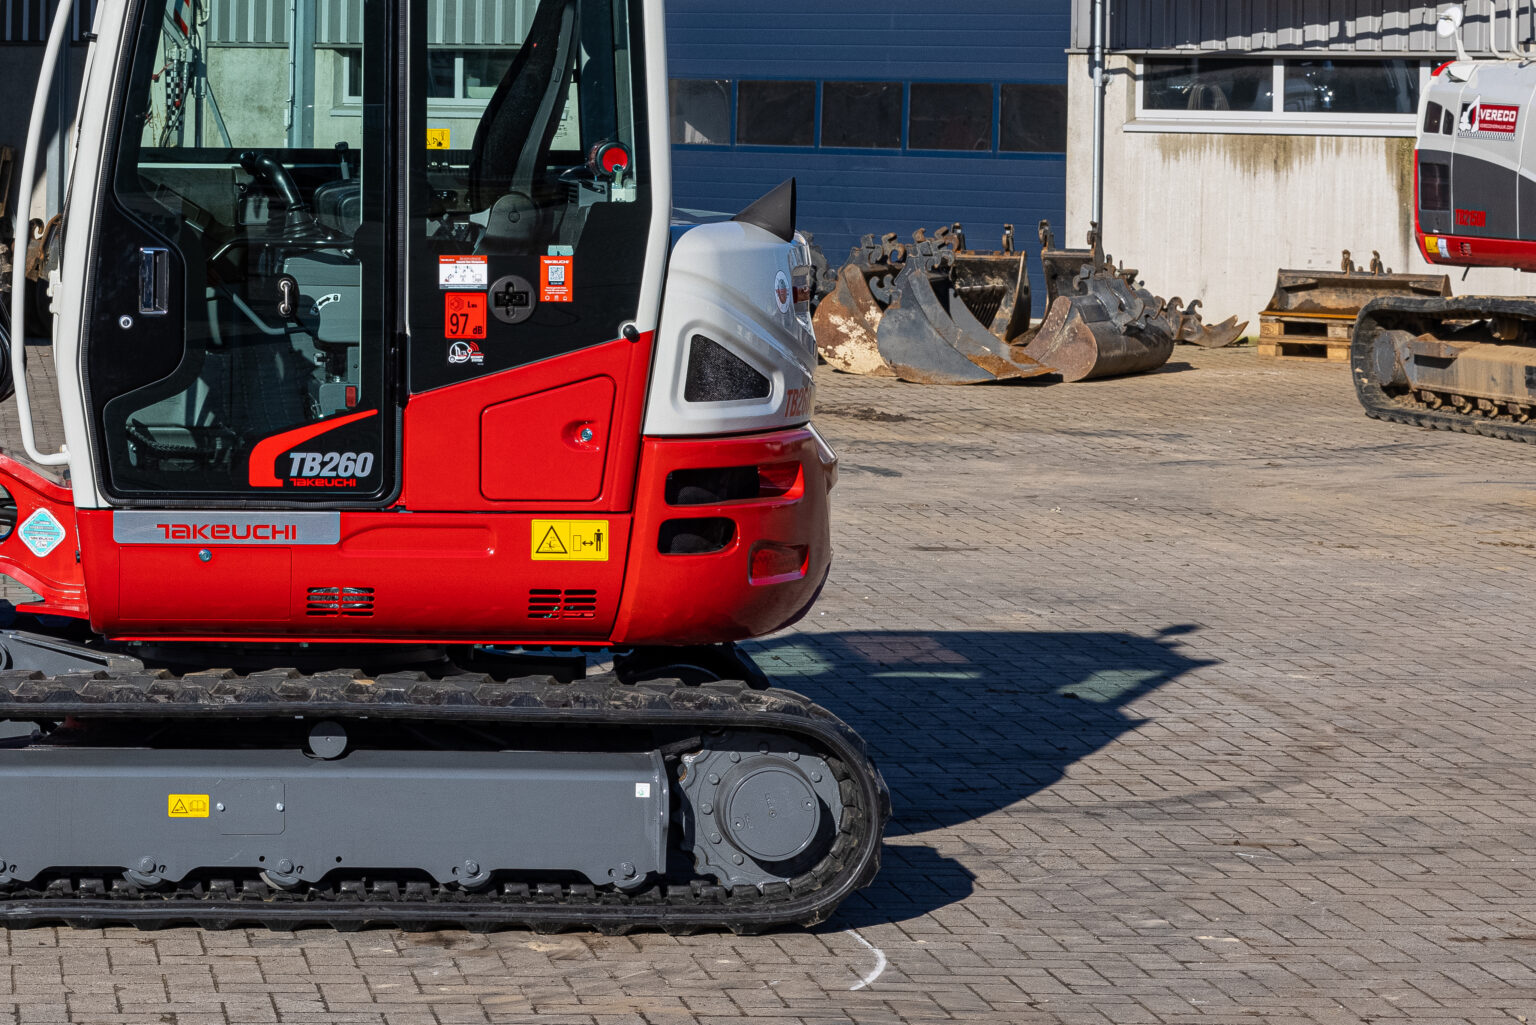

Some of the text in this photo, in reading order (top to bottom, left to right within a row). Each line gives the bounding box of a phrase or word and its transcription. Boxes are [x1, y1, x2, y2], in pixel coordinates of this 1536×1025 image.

[1480, 108, 1517, 123] VERECO
[449, 313, 483, 335] 97 dB
[289, 451, 374, 477] TB260
[288, 477, 357, 488] TAKEUCHI
[156, 523, 297, 541] TAKEUCHI
